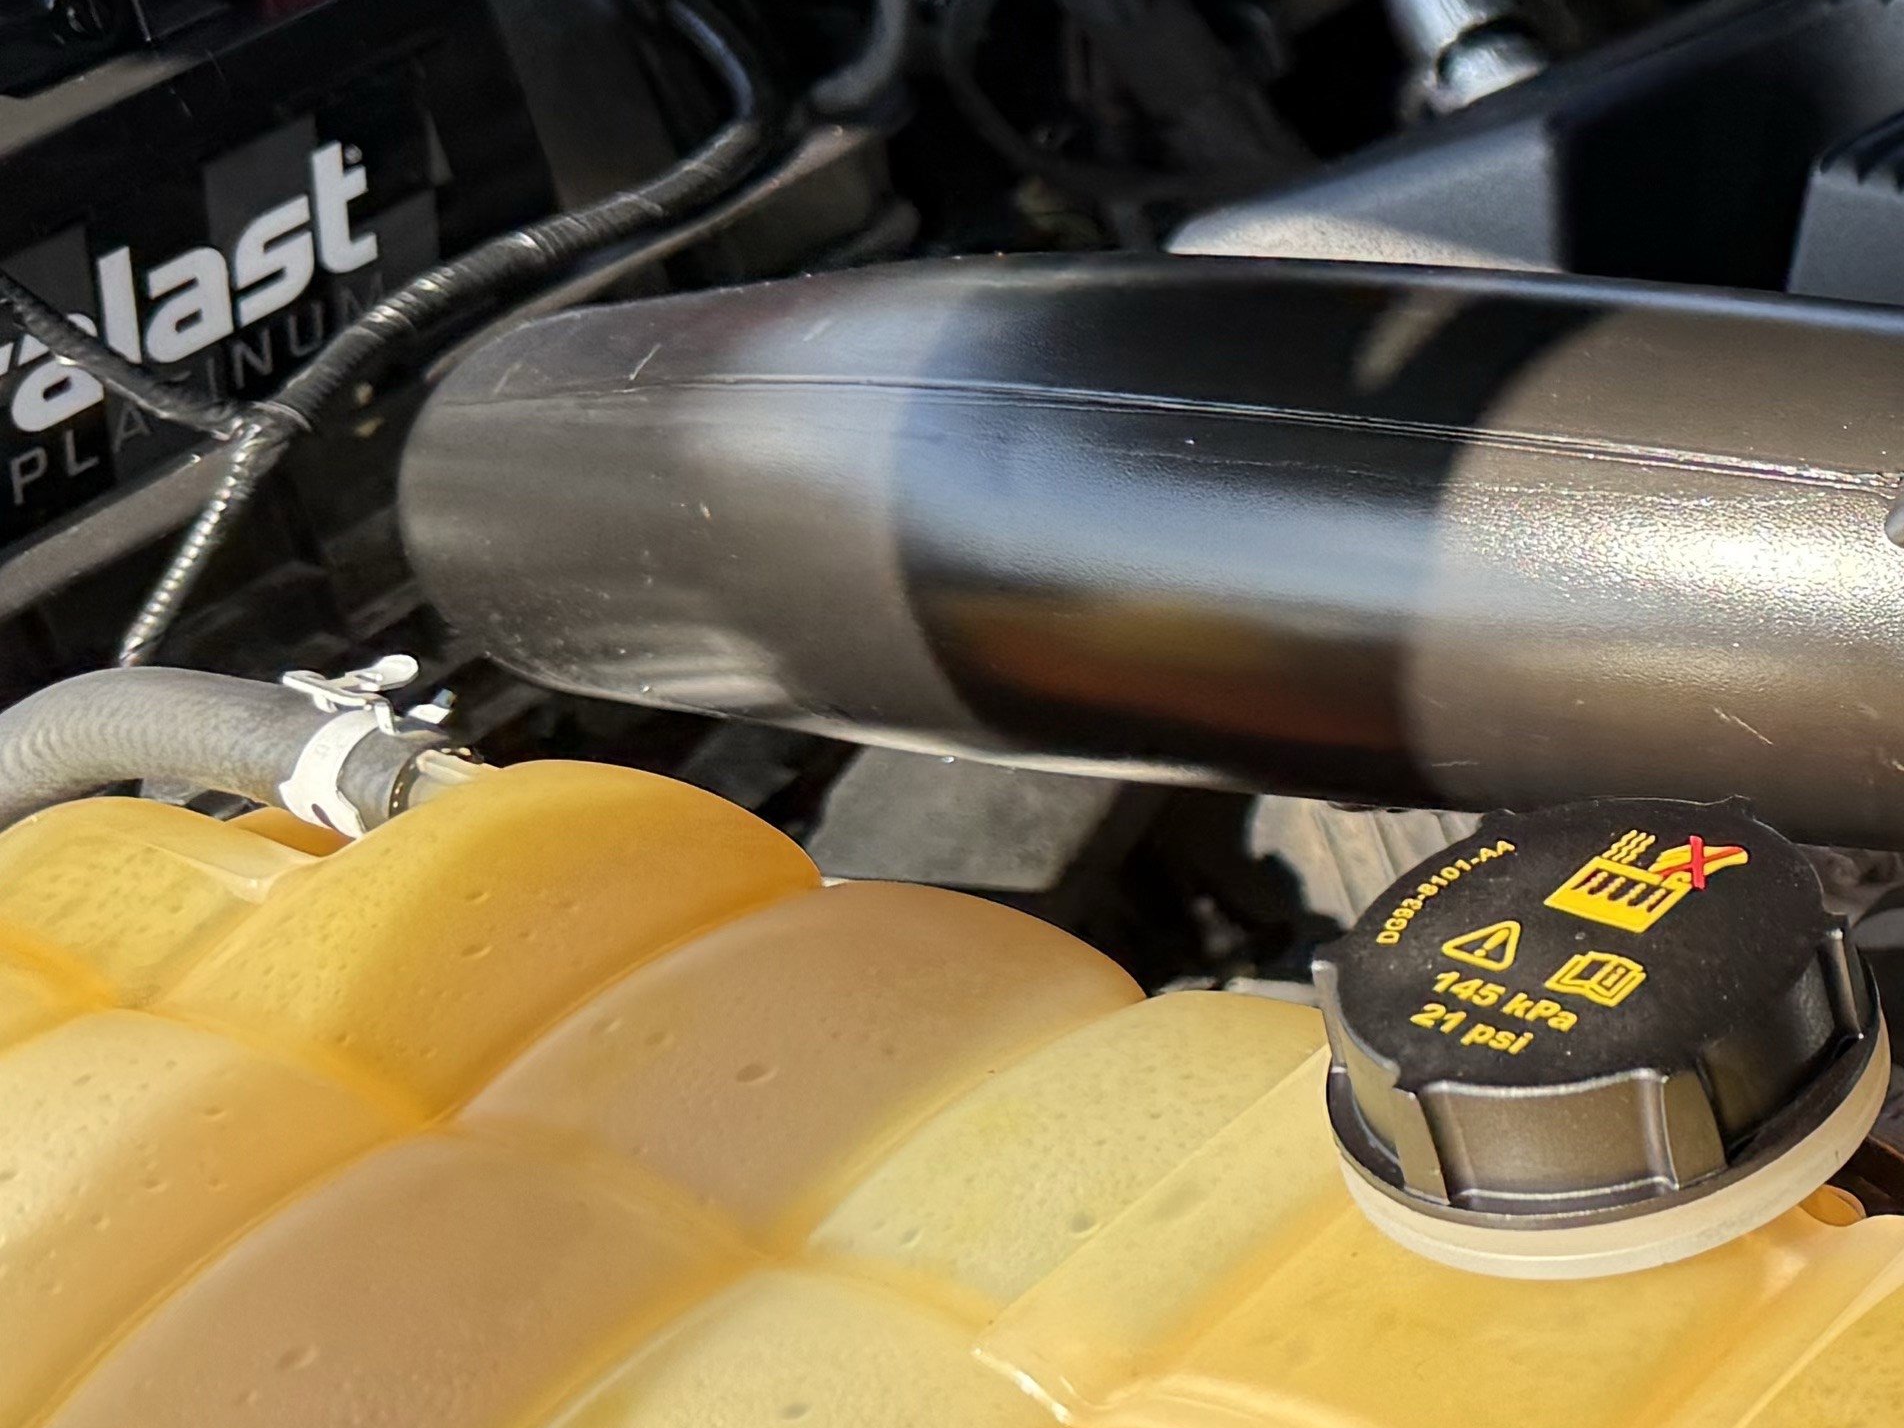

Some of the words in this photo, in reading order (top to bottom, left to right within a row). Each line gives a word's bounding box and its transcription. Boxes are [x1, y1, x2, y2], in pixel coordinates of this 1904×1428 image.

[0, 140, 379, 433] alast
[1410, 1003, 1467, 1034] 21
[1460, 1023, 1534, 1055] psi
[1432, 971, 1507, 1007] 145
[1502, 992, 1578, 1033] kPa
